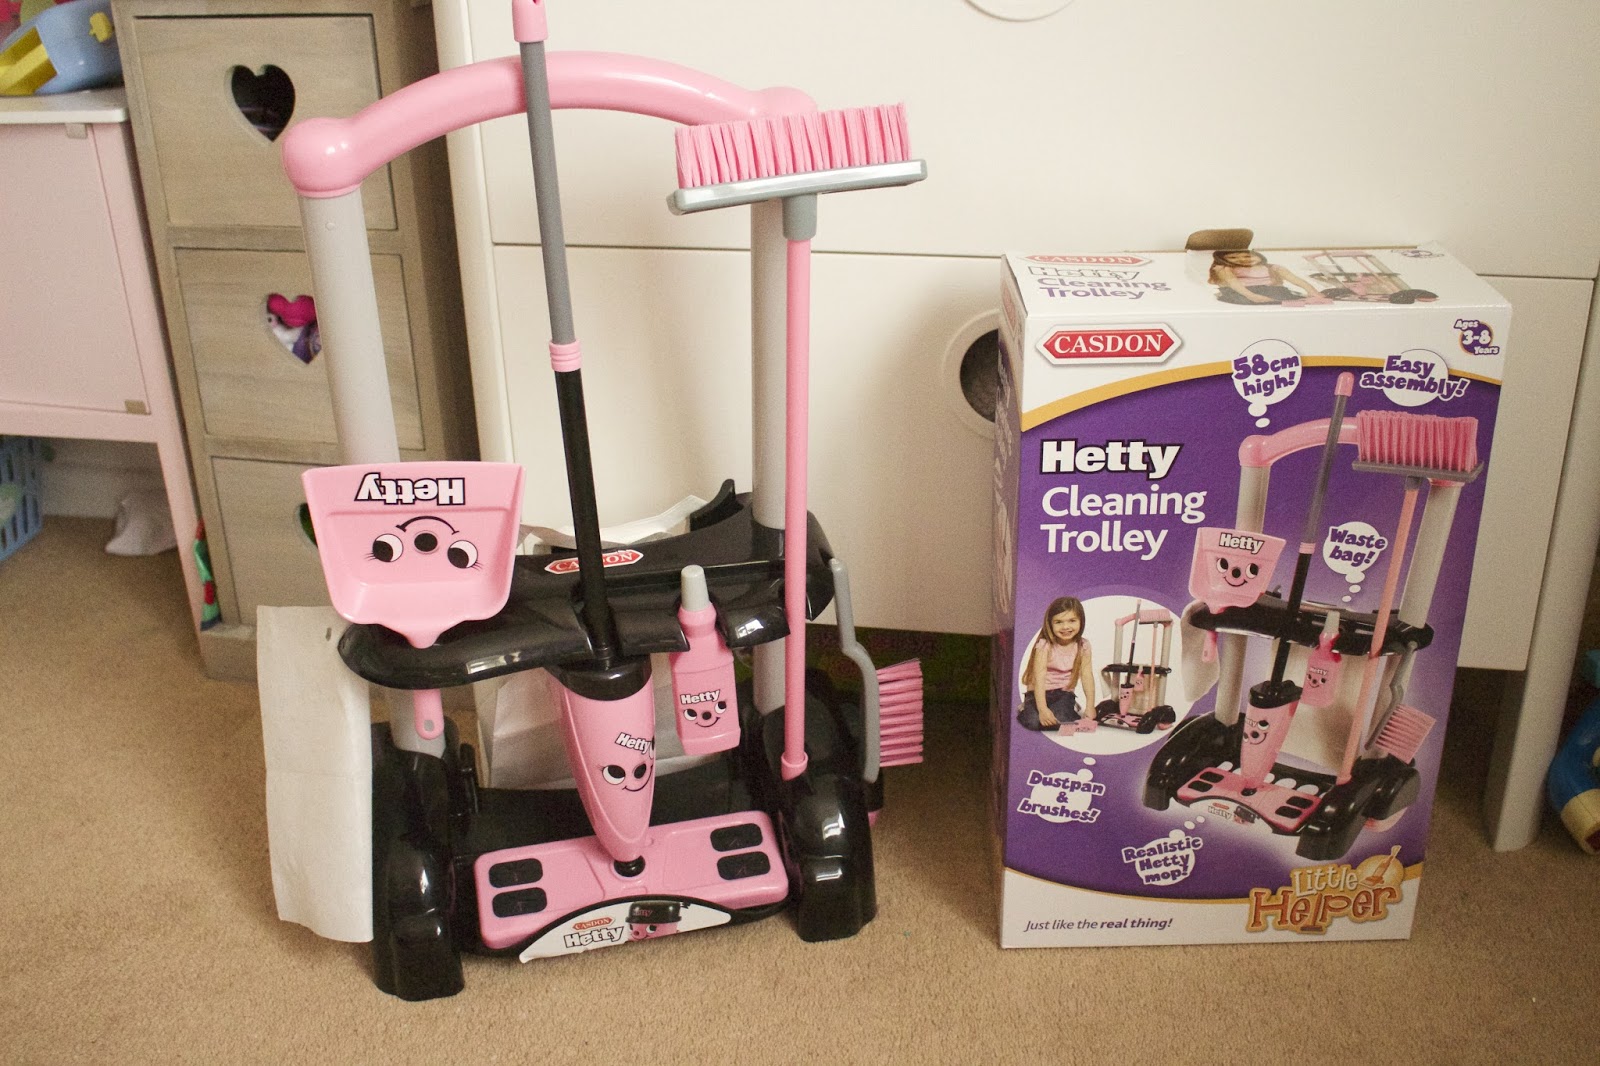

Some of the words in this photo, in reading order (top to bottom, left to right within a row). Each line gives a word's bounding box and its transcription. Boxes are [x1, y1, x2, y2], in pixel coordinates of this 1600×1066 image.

[1034, 255, 1133, 264] CASDON
[1028, 266, 1140, 281] Hetty
[1037, 277, 1172, 291] Cleaning
[1039, 287, 1145, 299] Trolley
[1454, 319, 1480, 330] Ages
[1054, 334, 1164, 354] CASDON
[1462, 330, 1491, 345] 3-8
[1473, 346, 1500, 355] Years
[1233, 354, 1300, 381] 58cm
[1385, 355, 1435, 378] Easy
[1243, 371, 1297, 396] high!
[1361, 374, 1469, 398] assembly!
[1040, 439, 1183, 480] Hetty
[354, 472, 465, 505] Hetty
[1042, 484, 1207, 524] Cleaning
[1040, 520, 1168, 561] Trolley
[1219, 532, 1265, 554] Hetty
[1329, 528, 1386, 549] Waste
[555, 552, 633, 570] CAON
[1329, 546, 1375, 567] bag!
[680, 689, 721, 705] Hetty
[615, 732, 651, 755] Hetty
[1029, 771, 1104, 794] Dustpan
[1056, 791, 1068, 803] &
[1020, 801, 1098, 822] brushes!
[1124, 838, 1202, 862] Realistic
[1139, 854, 1190, 872] Hetty
[1145, 866, 1188, 883] mop!
[1294, 867, 1359, 896] Little
[1251, 887, 1397, 931] Helper
[576, 918, 610, 931] CASDON
[1024, 920, 1050, 932] Just
[1052, 920, 1074, 930] like
[1077, 919, 1098, 929] the
[1100, 918, 1127, 929] real
[1130, 918, 1173, 930] thing!
[564, 926, 624, 948] Hetty
